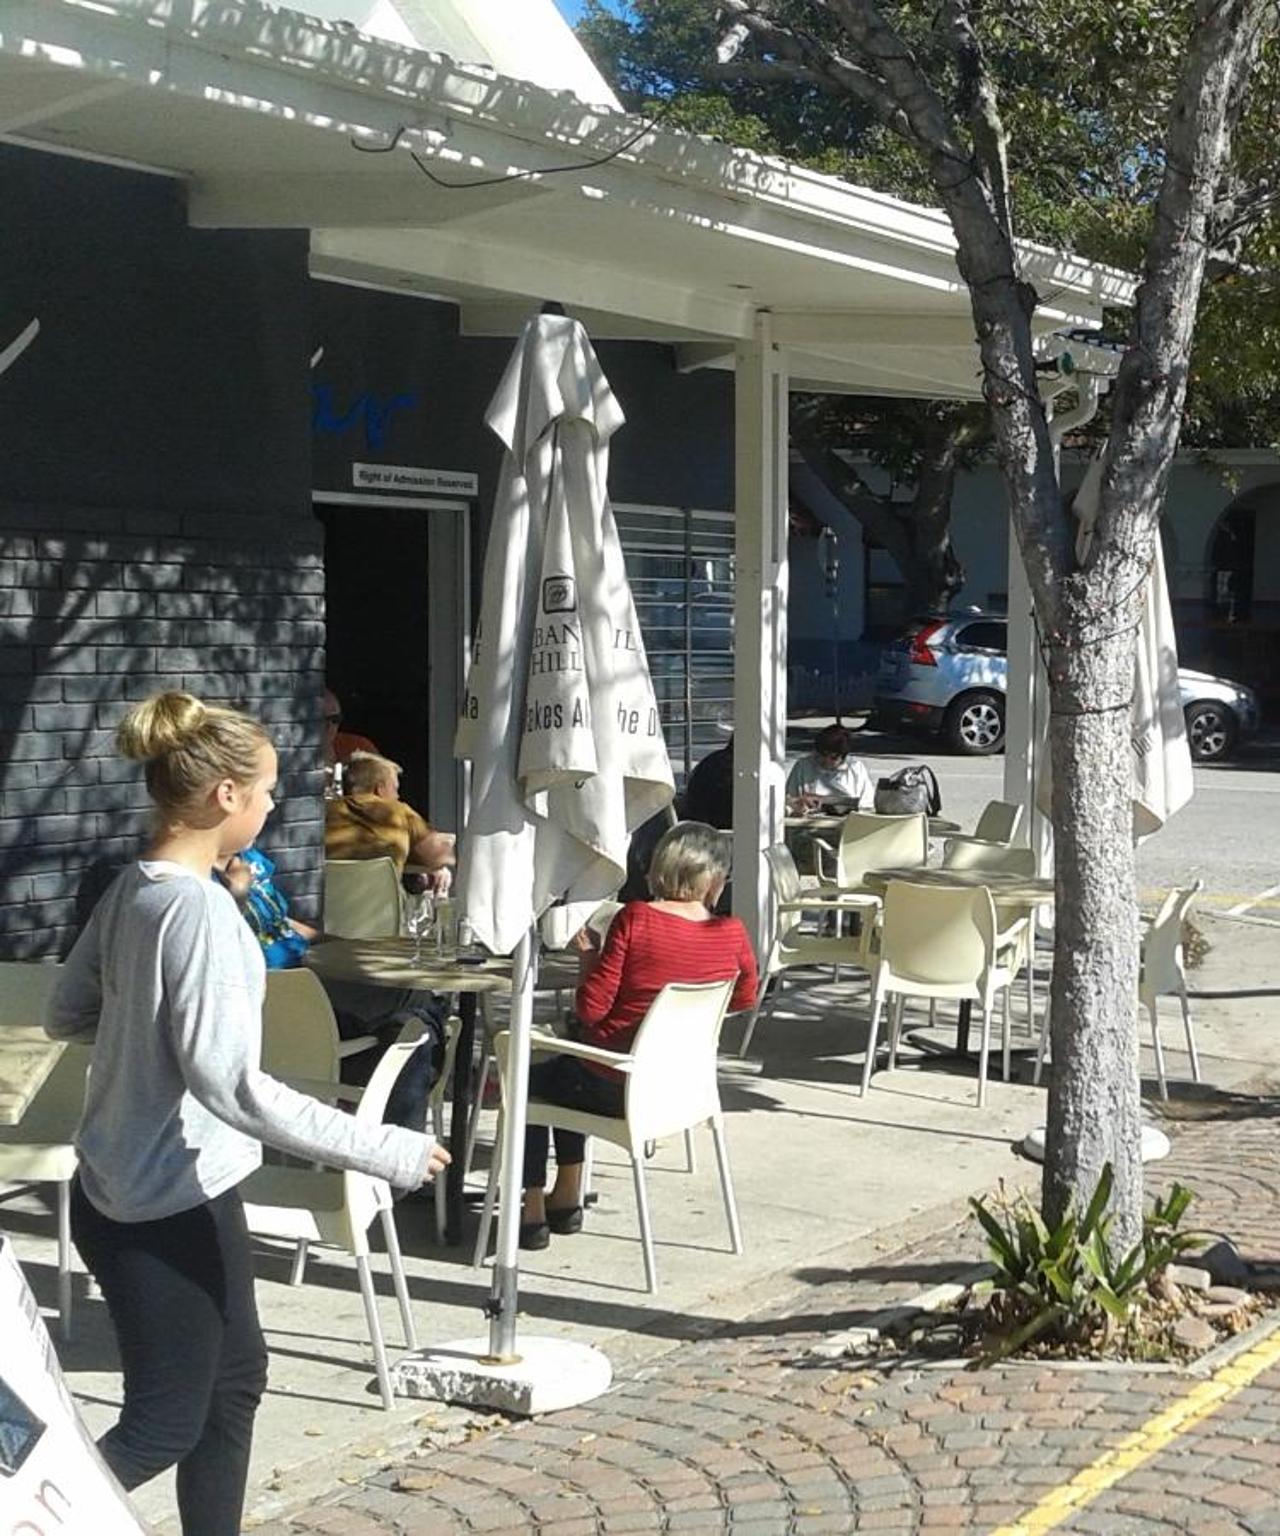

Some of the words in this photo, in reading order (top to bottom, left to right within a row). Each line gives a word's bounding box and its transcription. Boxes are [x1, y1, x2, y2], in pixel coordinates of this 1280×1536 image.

[358, 470, 381, 484] Right
[383, 473, 393, 483] of
[394, 473, 435, 487] Admission
[437, 477, 474, 490] Reserved
